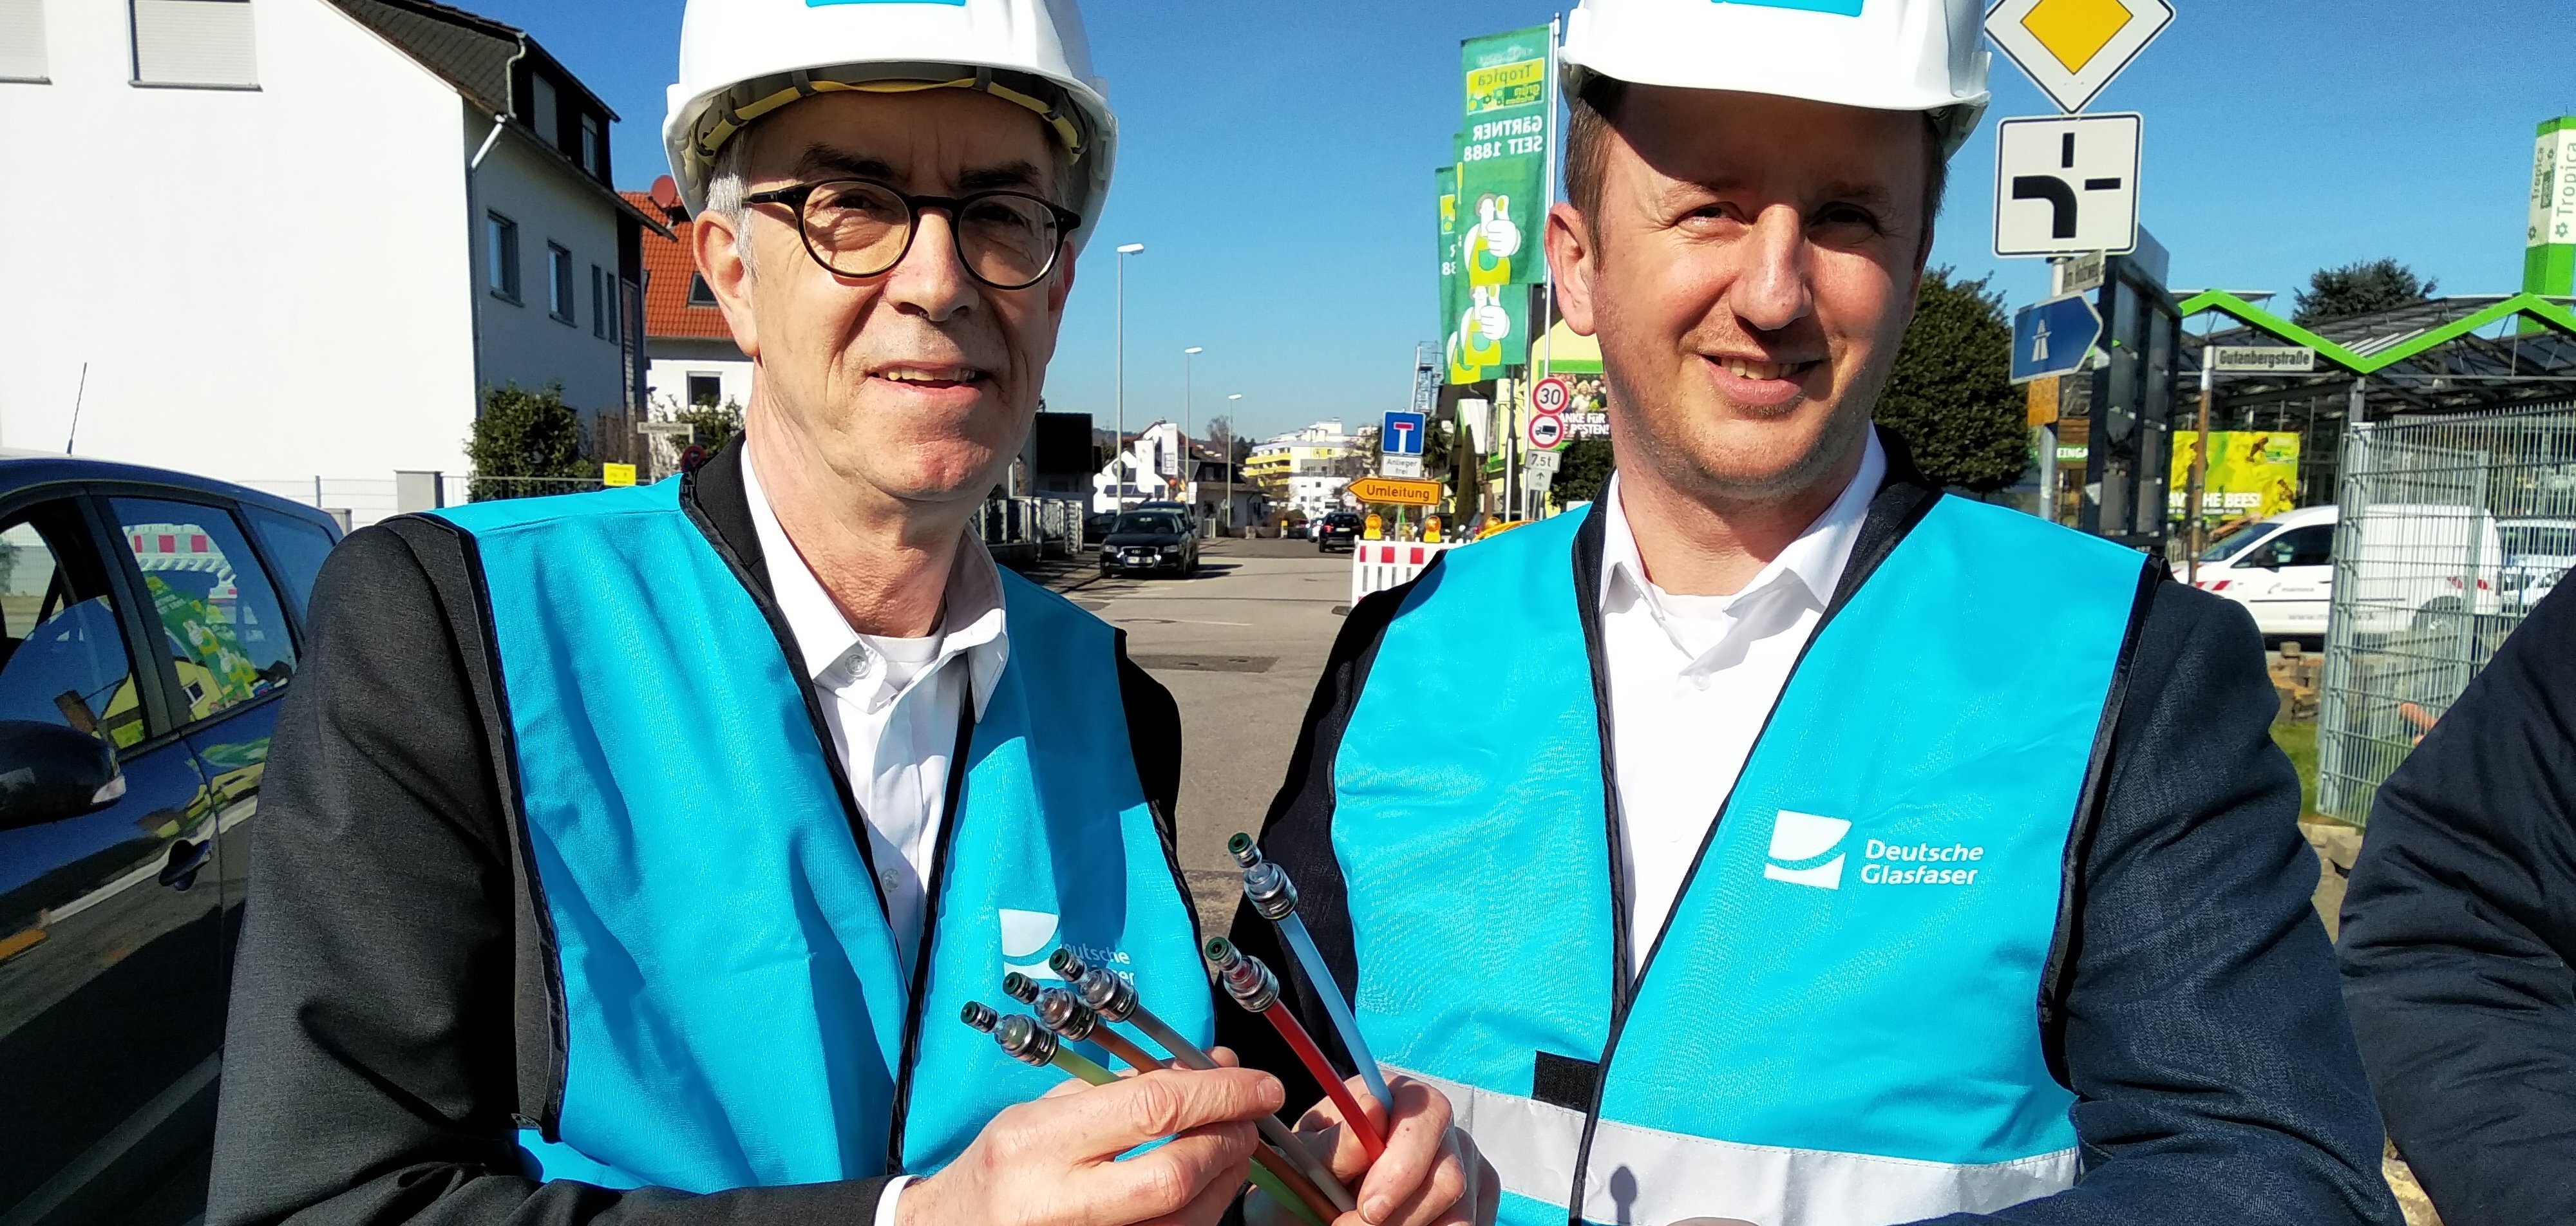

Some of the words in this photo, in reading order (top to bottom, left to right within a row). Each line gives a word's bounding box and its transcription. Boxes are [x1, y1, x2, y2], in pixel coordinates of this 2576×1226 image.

[2556, 143, 2576, 217] Tropica
[2220, 350, 2309, 368] Gutenbergstraße
[1540, 388, 1560, 405] 30
[1559, 413, 1585, 423] ANKE
[1387, 458, 1417, 467] Anlieger
[1367, 484, 1430, 502] Umleitung
[2202, 493, 2222, 507] HE
[1865, 839, 1984, 862] Deutsche
[1861, 863, 1978, 885] Glasfaser
[1059, 943, 1130, 964] eutsche
